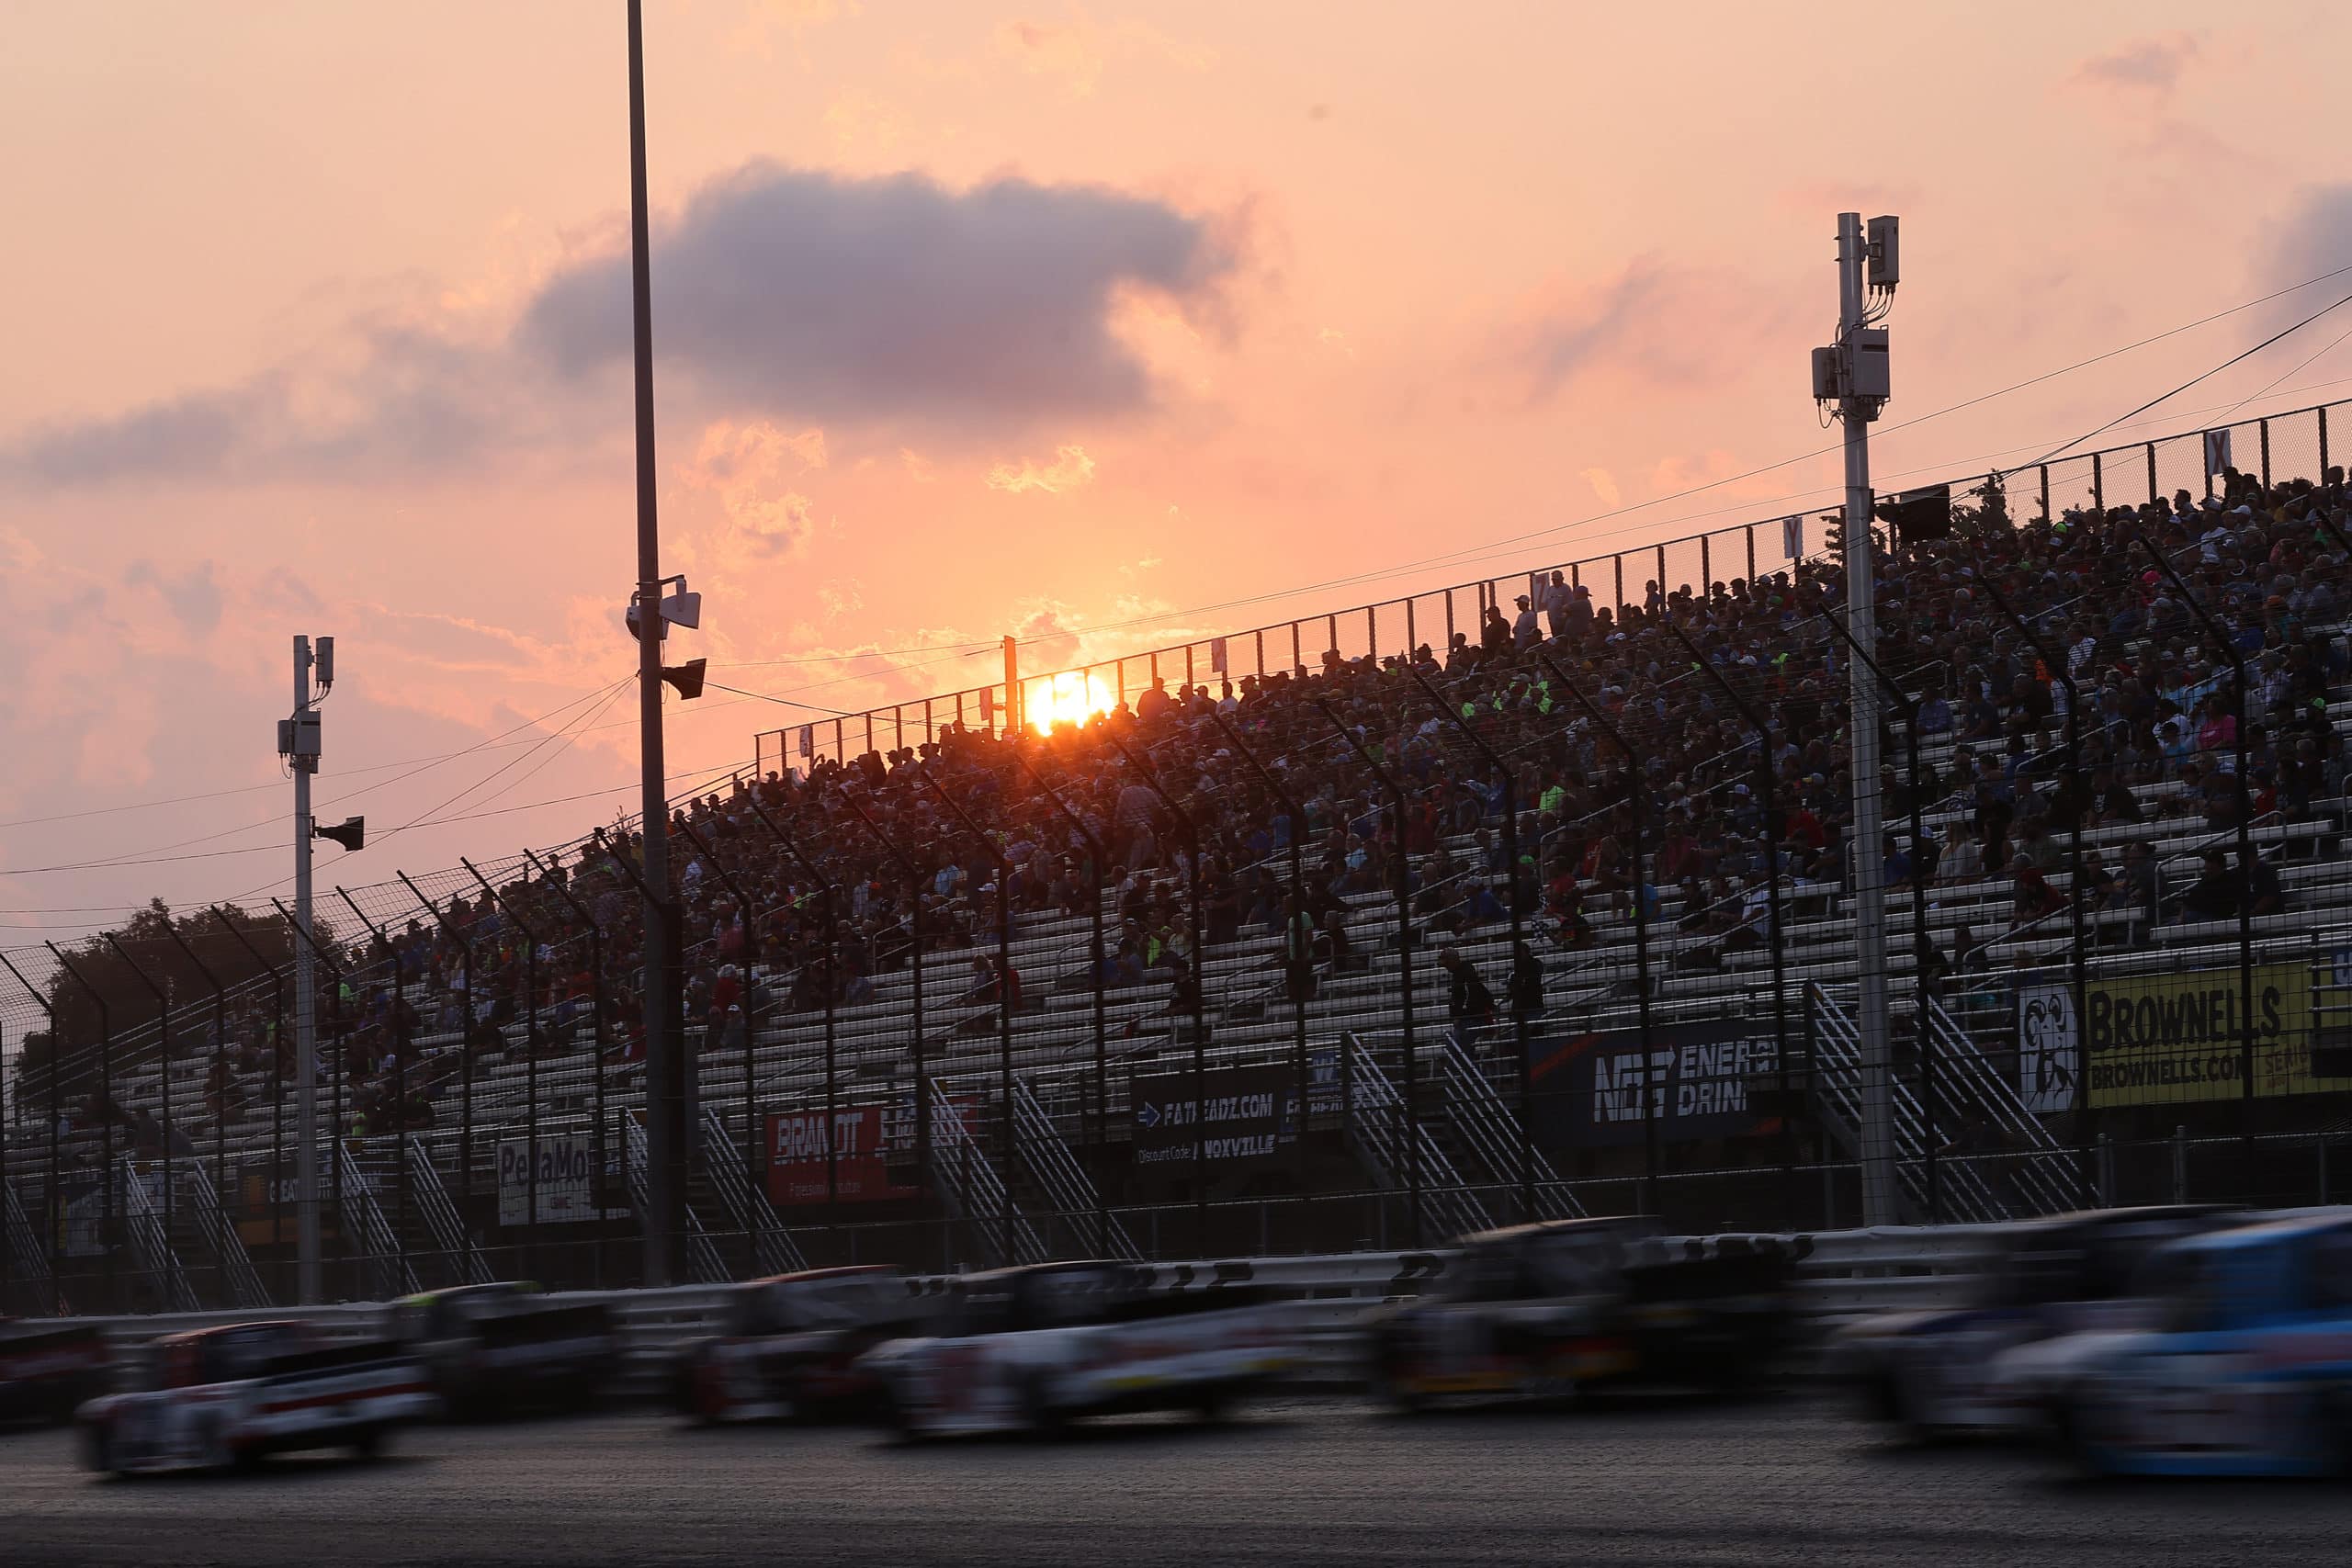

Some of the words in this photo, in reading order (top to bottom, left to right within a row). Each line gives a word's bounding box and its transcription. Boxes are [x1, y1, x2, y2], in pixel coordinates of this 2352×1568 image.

[2211, 432, 2227, 474] X
[1785, 519, 1798, 558] Y
[2088, 986, 2279, 1052] BROWNELS
[1678, 1077, 1747, 1117] DRIN
